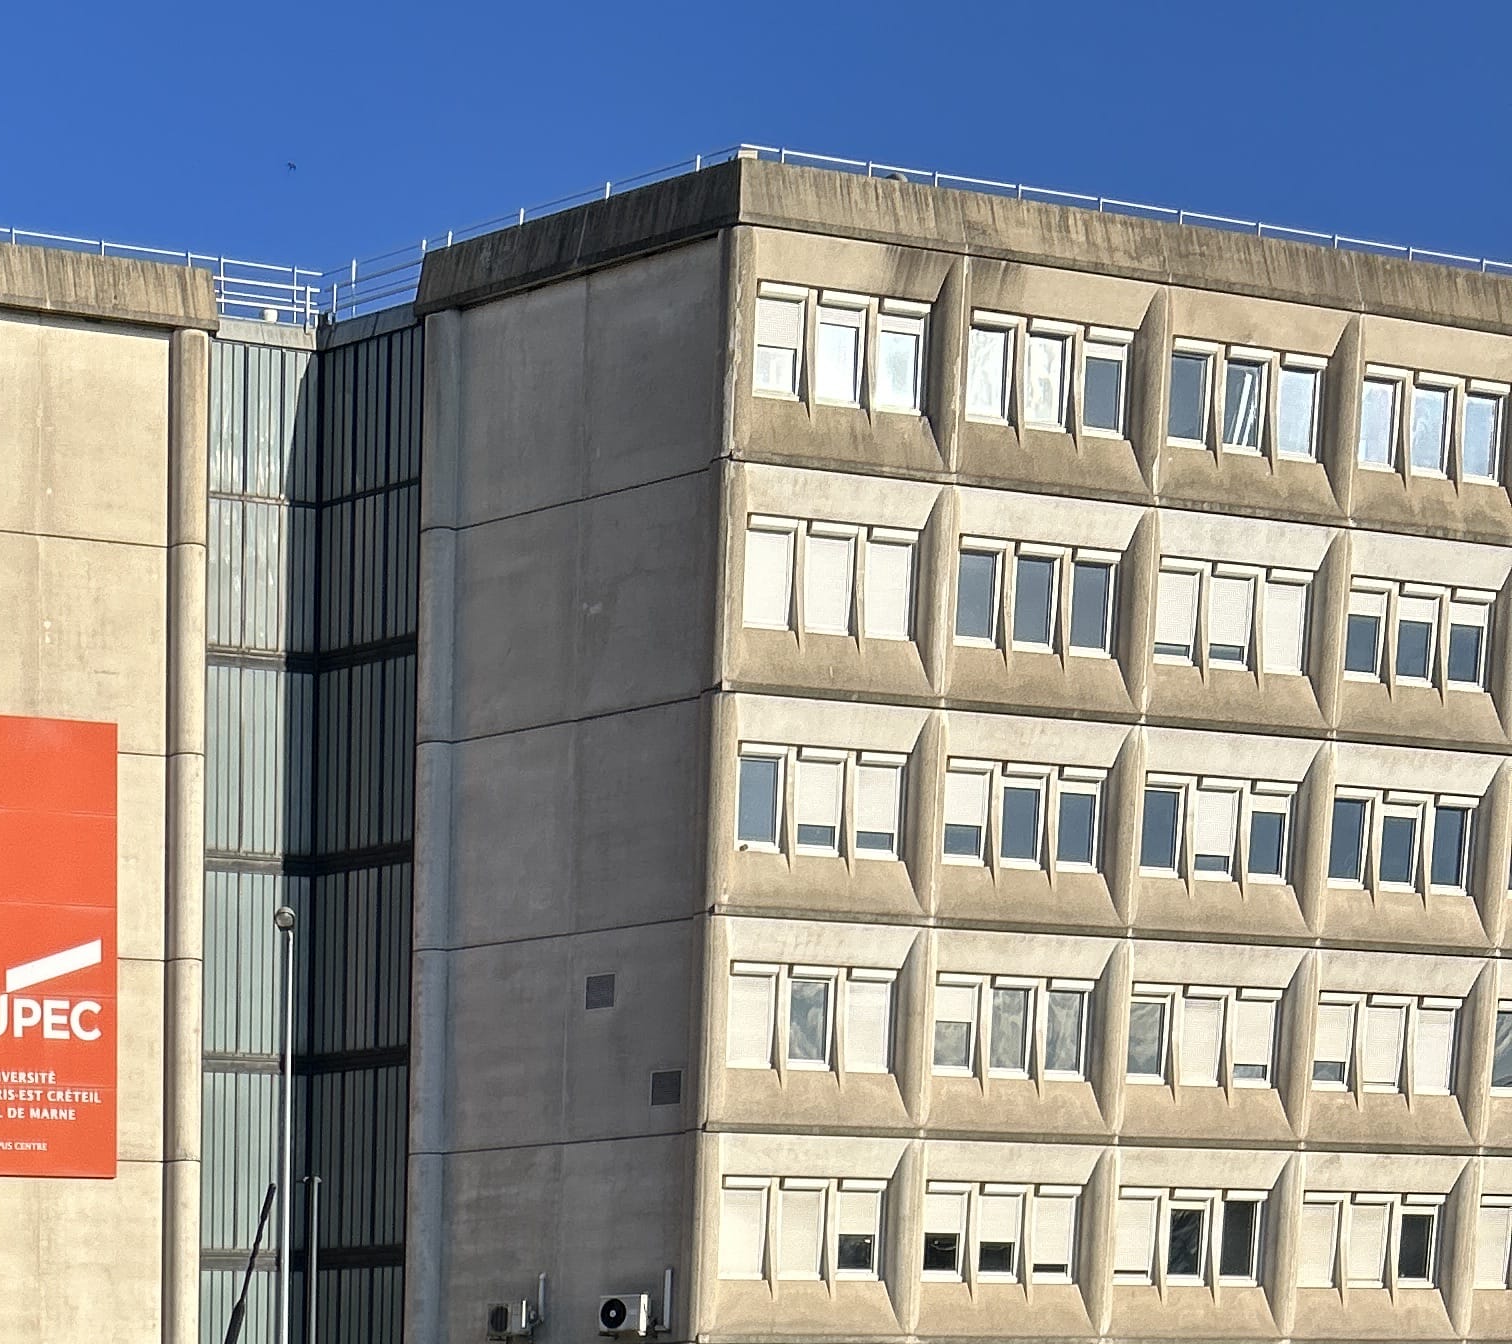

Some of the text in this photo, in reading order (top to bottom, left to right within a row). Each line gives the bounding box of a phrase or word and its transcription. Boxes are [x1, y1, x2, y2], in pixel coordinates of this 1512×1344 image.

[46, 1089, 102, 1104] CRÉTEIL
[7, 1107, 25, 1119] DE
[29, 1108, 76, 1121] MARNE
[14, 1141, 48, 1151] CENTRE
